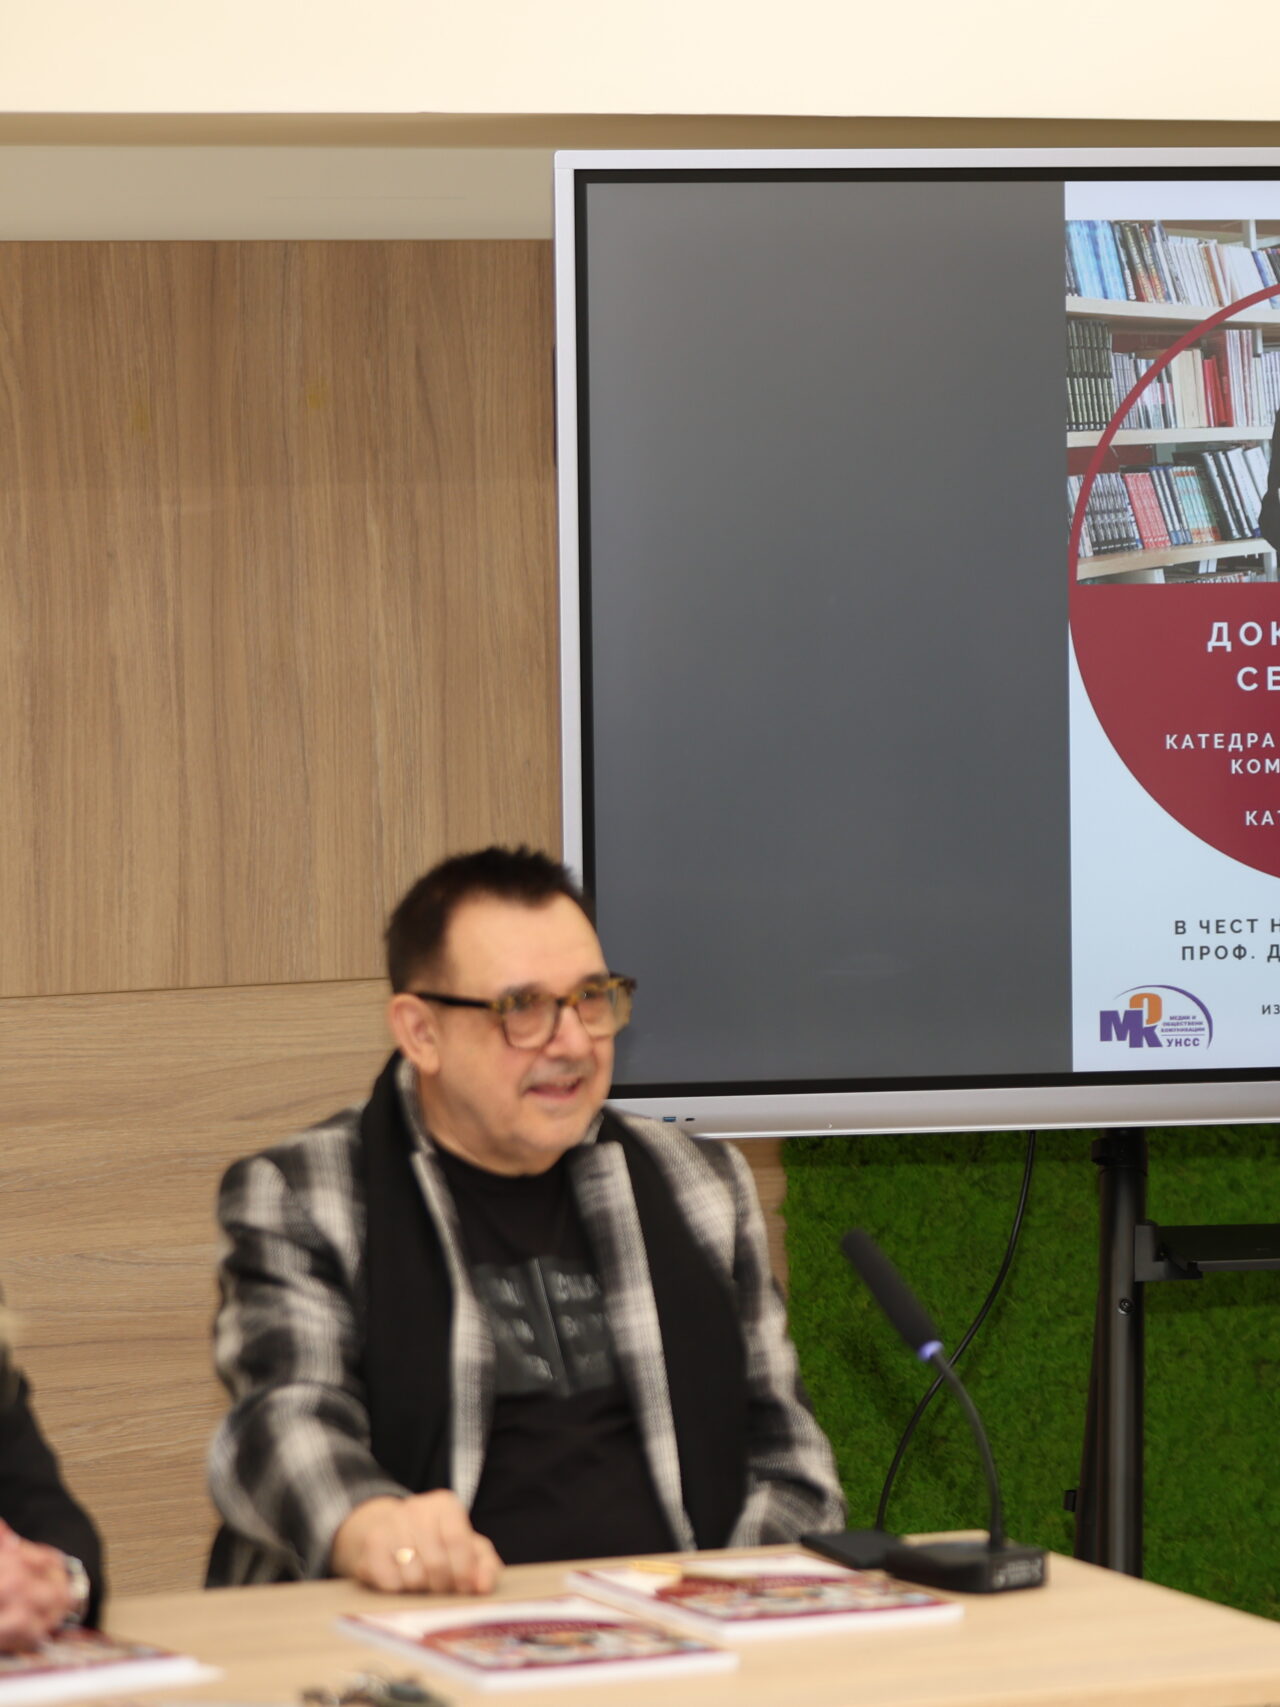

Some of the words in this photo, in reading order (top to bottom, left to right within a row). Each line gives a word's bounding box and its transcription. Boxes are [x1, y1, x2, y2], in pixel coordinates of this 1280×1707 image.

[1165, 732, 1275, 753] КАТЕДРА
[1174, 919, 1187, 935] В
[1199, 918, 1259, 935] ЧЕСТ
[1181, 943, 1255, 961] ПРОФ.
[1166, 1038, 1200, 1048] УНСС
